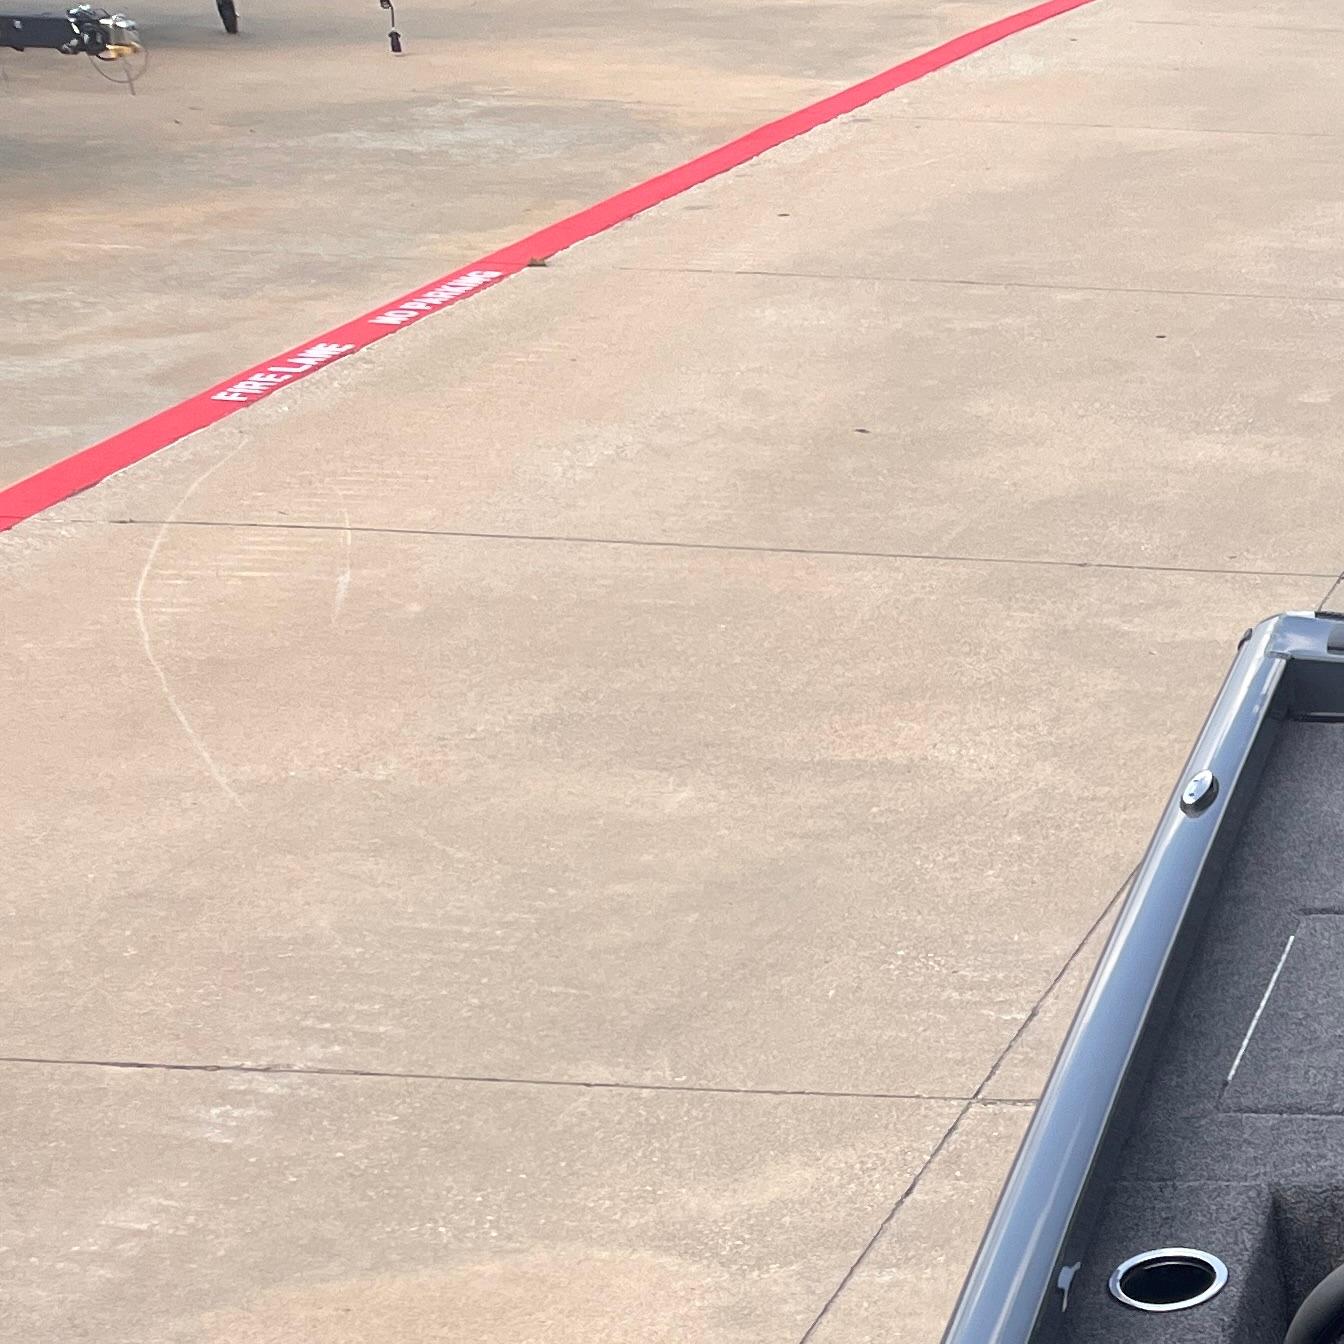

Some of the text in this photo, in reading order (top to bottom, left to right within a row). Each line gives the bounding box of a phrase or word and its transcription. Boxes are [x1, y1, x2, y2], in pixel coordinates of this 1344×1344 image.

[211, 270, 502, 402] FIRE LANE NO PARKING
